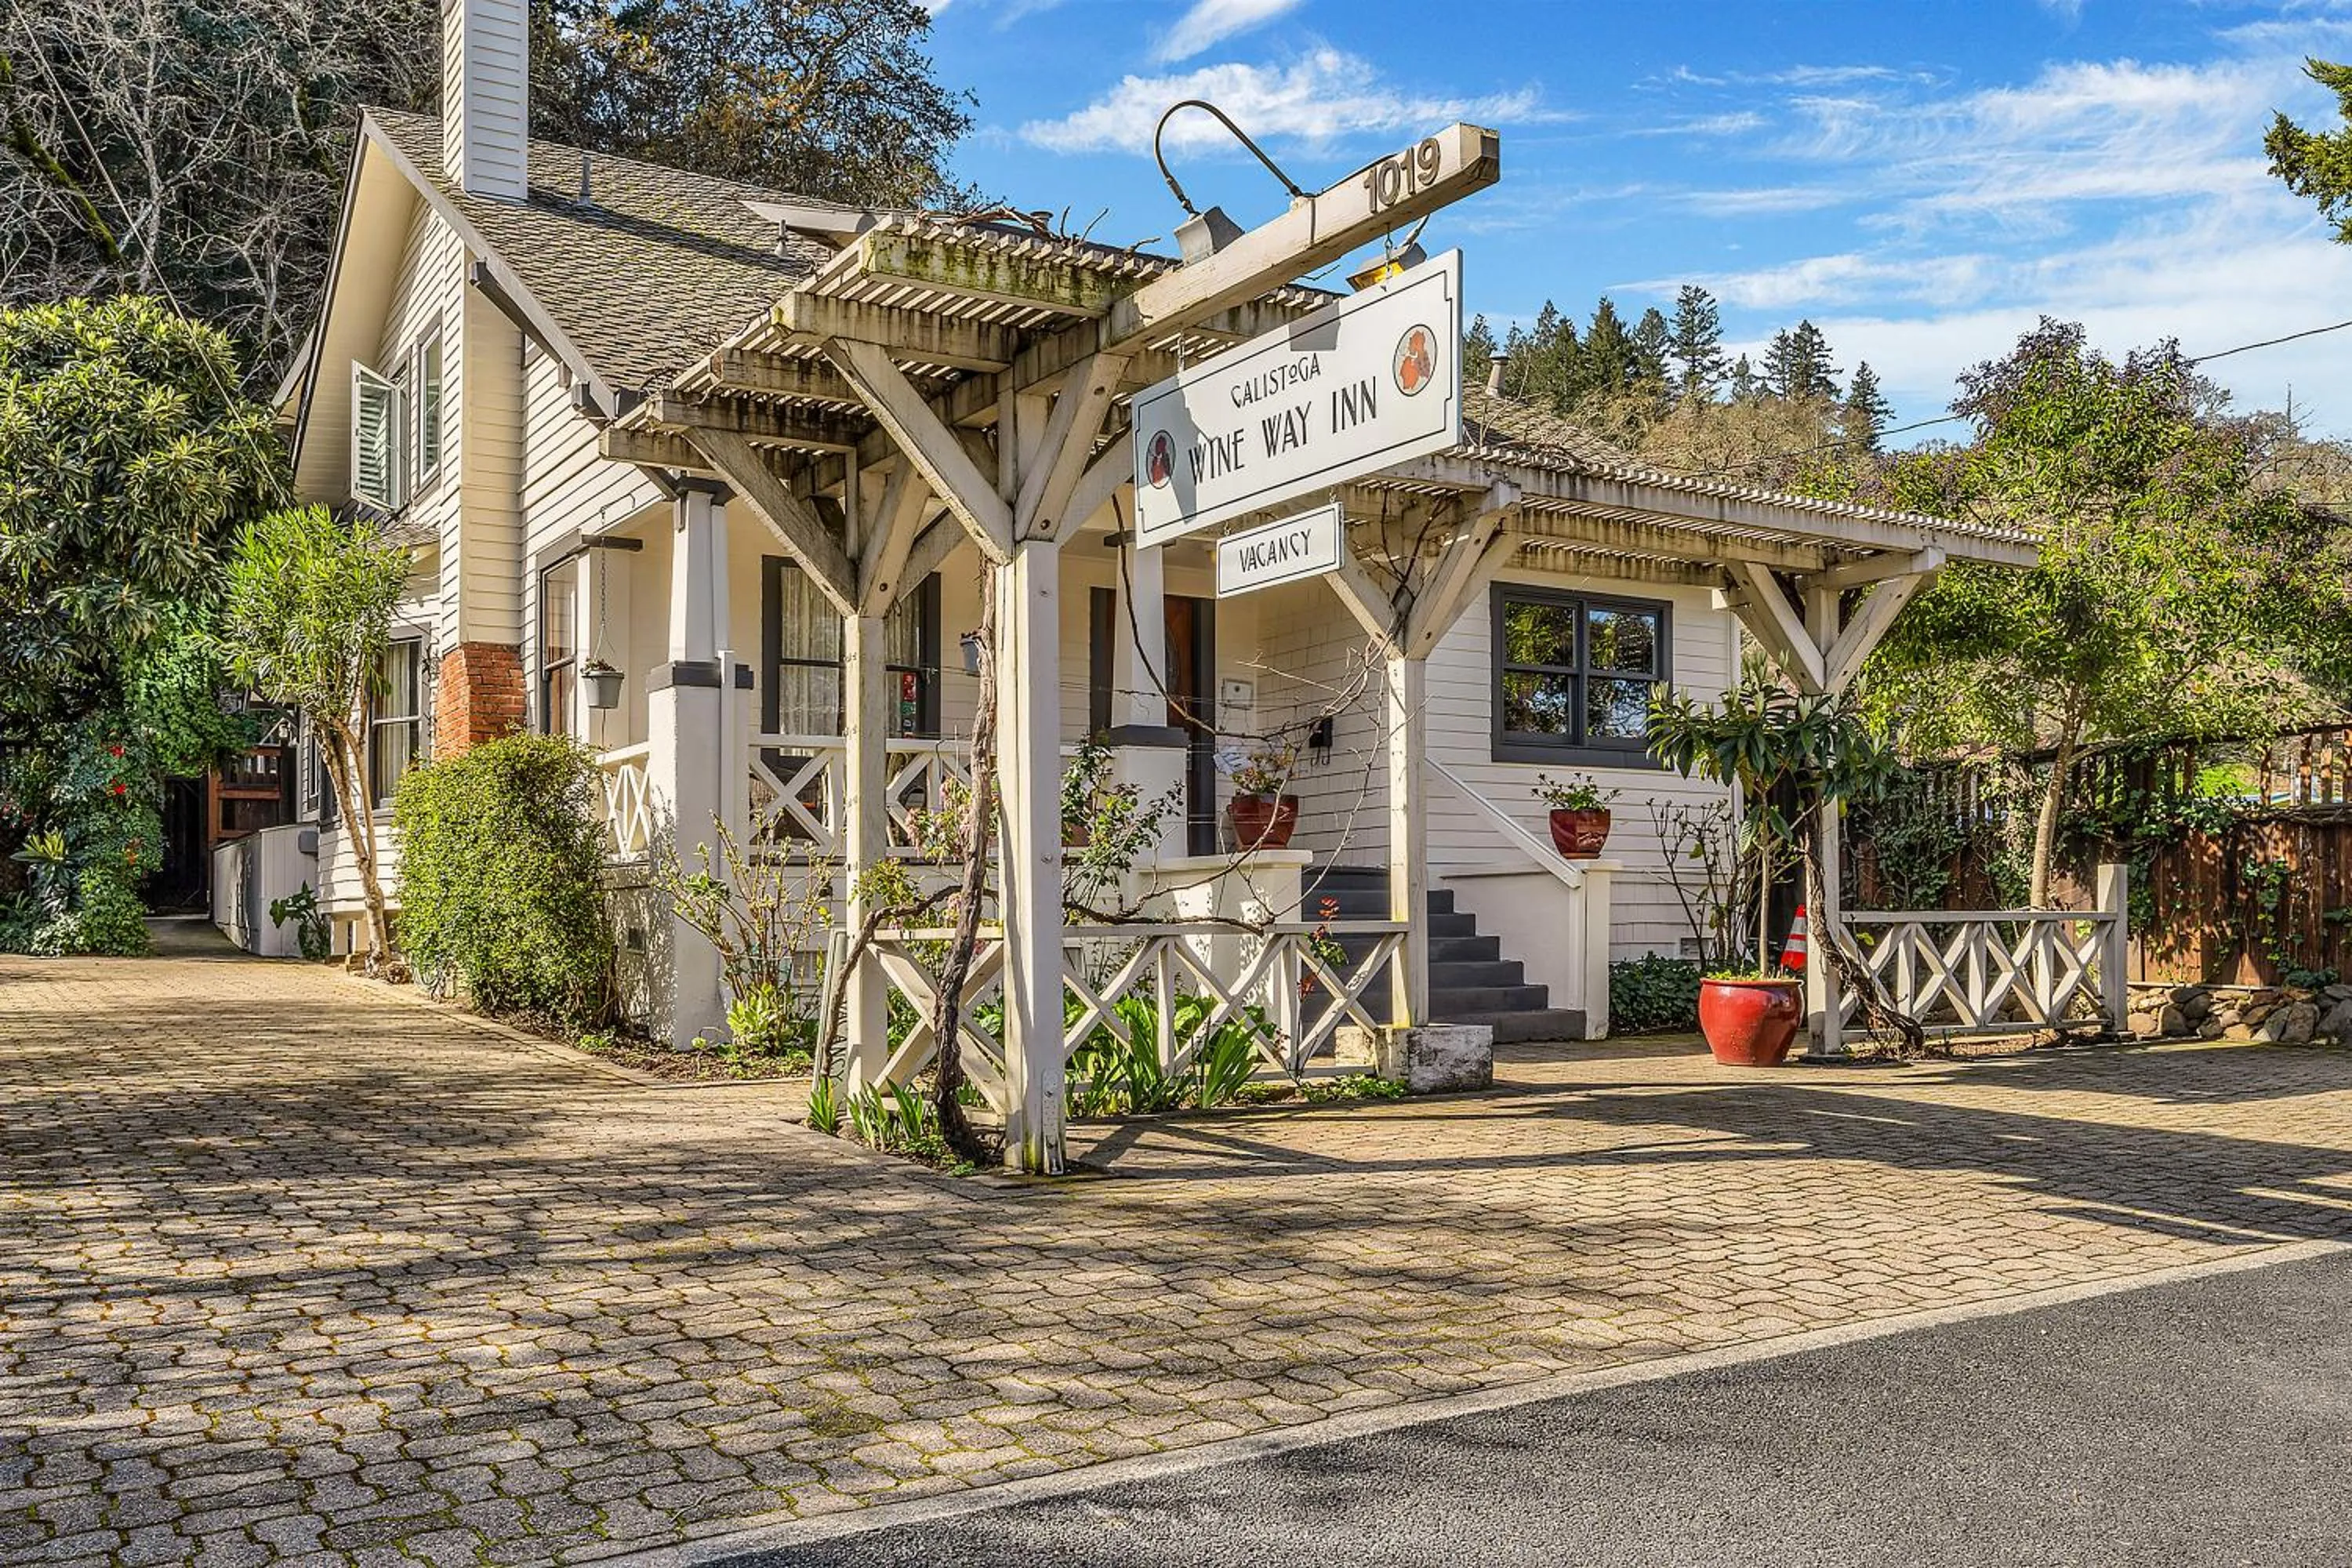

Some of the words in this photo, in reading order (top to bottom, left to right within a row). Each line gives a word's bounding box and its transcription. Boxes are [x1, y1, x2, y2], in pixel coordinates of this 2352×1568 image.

[1364, 137, 1440, 213] 1019
[1231, 353, 1321, 408] CALISTOGA
[1189, 429, 1245, 485] WINE
[1262, 401, 1312, 458] WAY
[1332, 376, 1377, 434] INN
[1240, 528, 1312, 572] VACANCY
